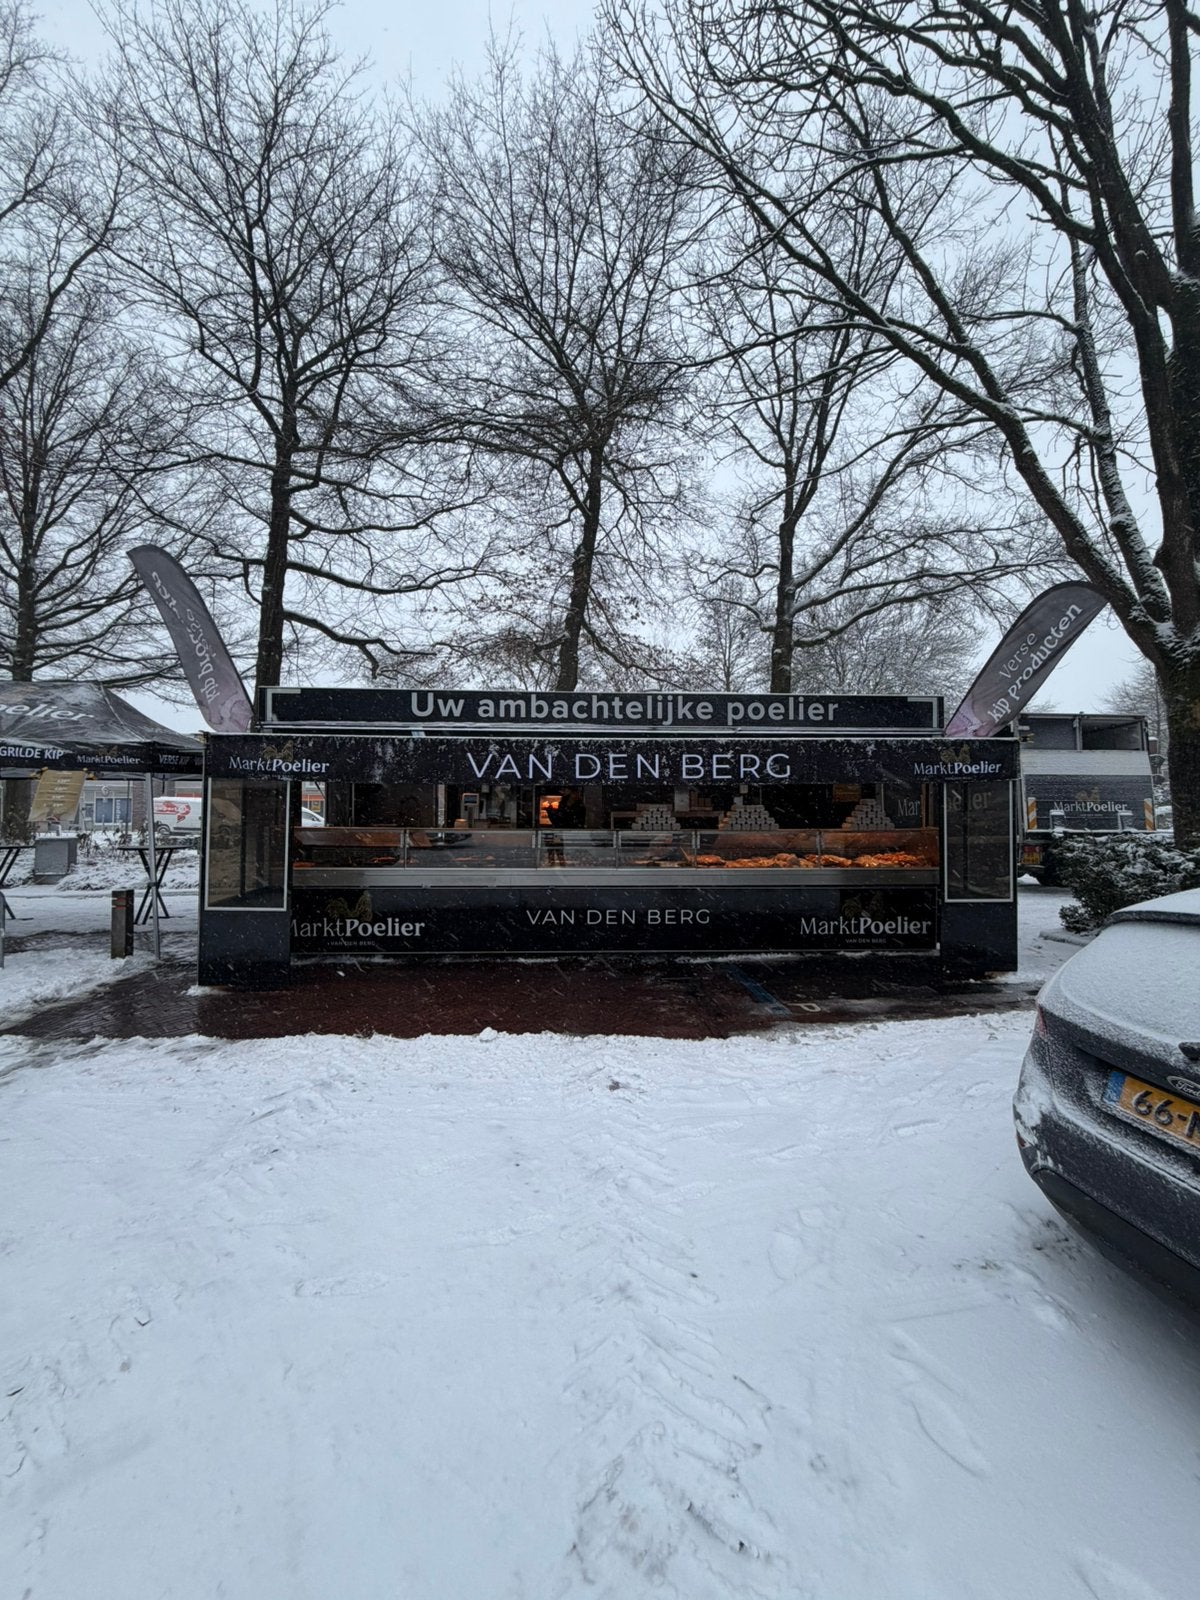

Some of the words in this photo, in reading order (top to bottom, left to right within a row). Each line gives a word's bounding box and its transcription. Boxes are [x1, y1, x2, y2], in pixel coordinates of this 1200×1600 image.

[987, 697, 1012, 722] kip
[1008, 603, 1083, 701] producten
[411, 692, 465, 717] Uw
[477, 694, 714, 726] ambachtelijke
[726, 696, 838, 726] poelier
[44, 749, 64, 760] KIP
[228, 756, 330, 773] MarktPoelier
[467, 752, 553, 779] VAN
[575, 753, 660, 779] DEN
[682, 752, 791, 779] BERG
[913, 761, 1002, 775] MarktPoelier
[526, 909, 576, 925] VAN
[586, 909, 636, 925] DEN
[647, 908, 711, 925] BERG
[799, 916, 932, 935] MarktPoelier
